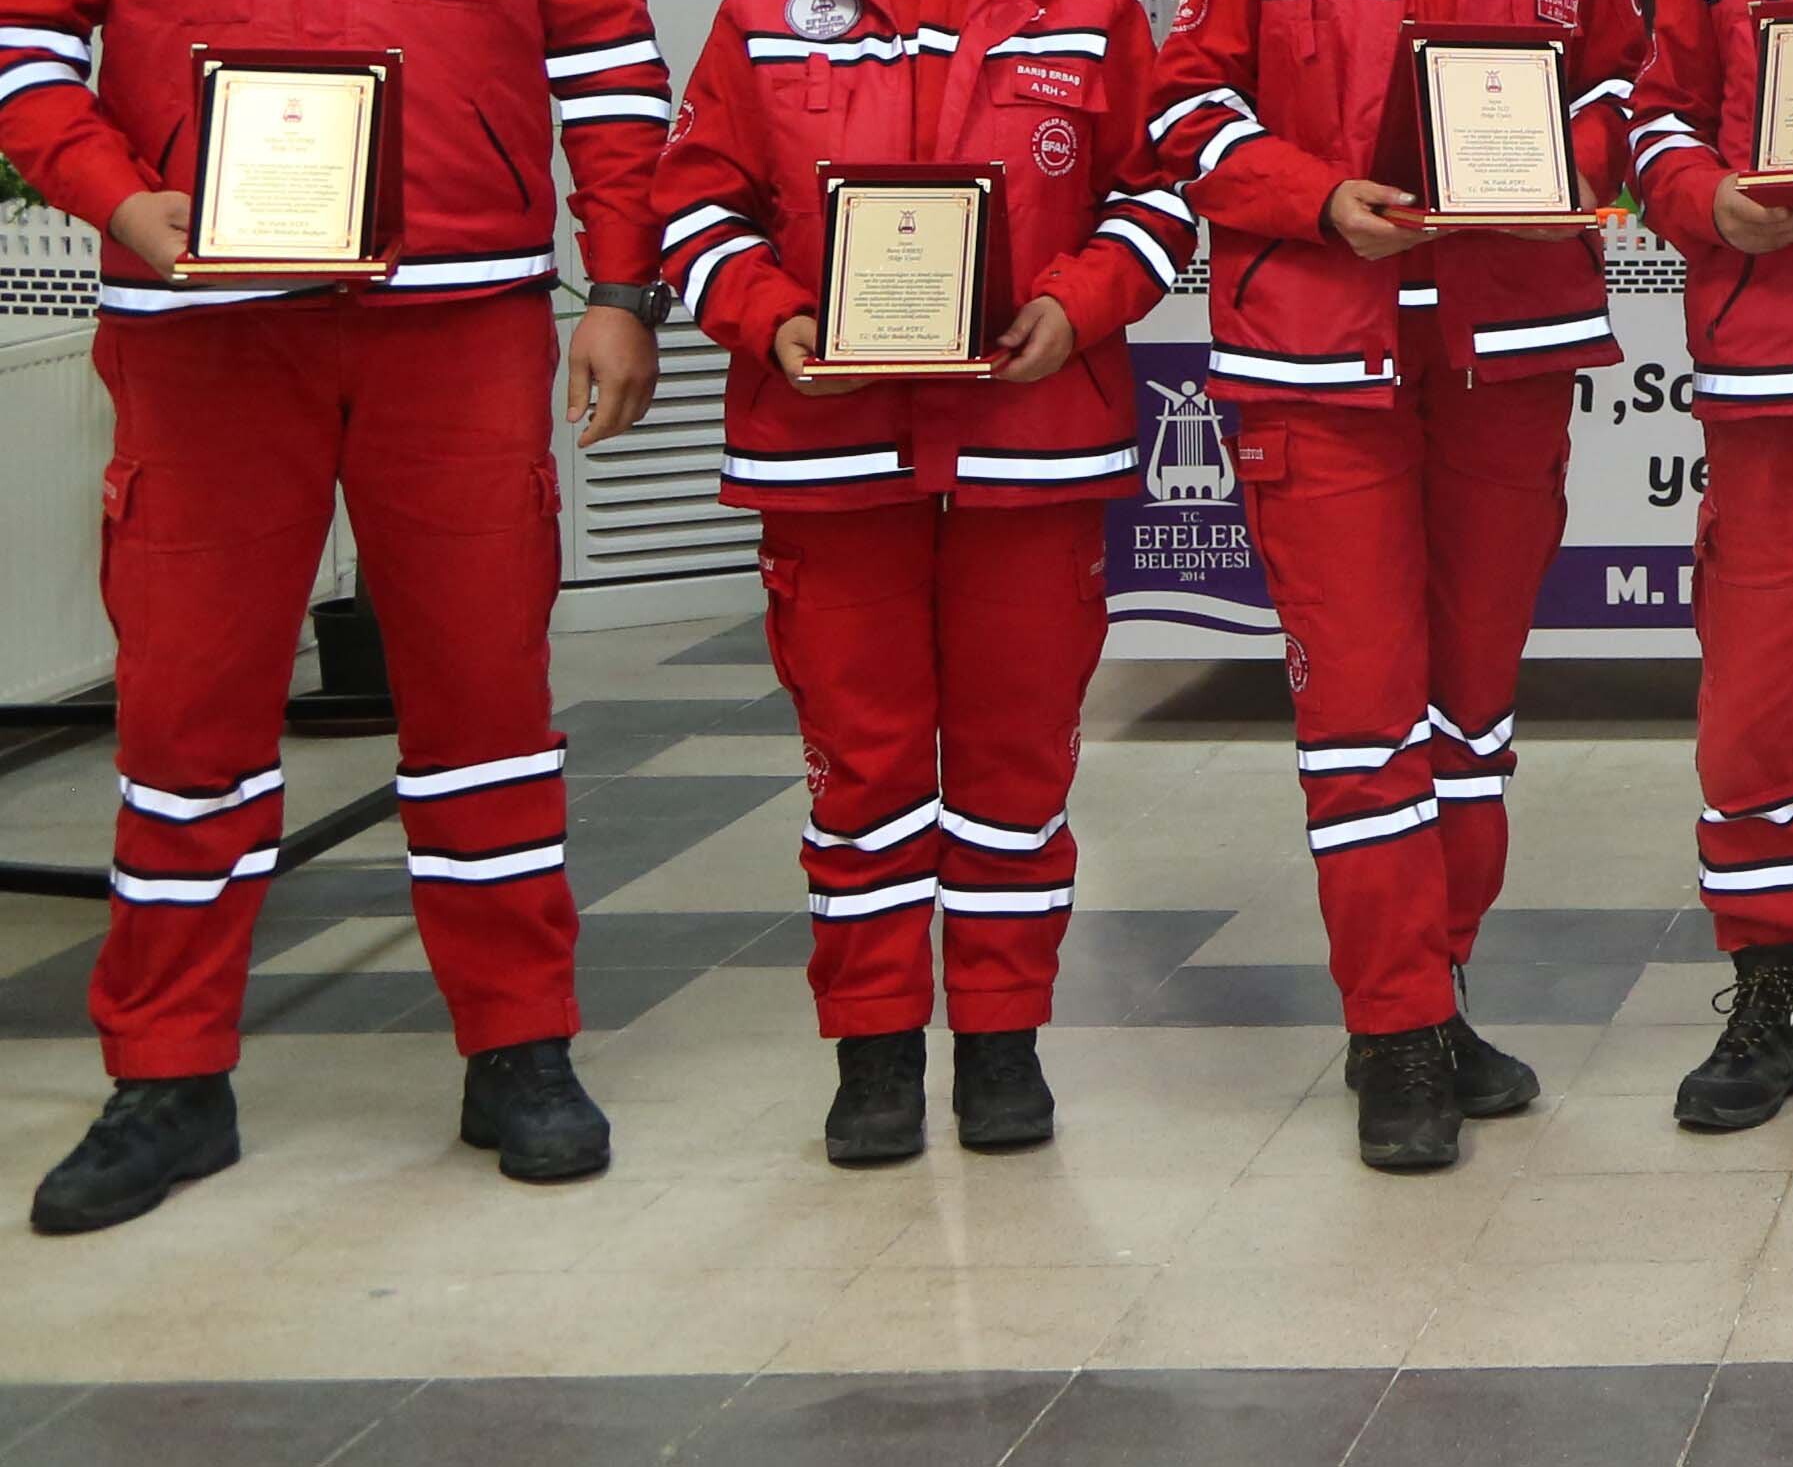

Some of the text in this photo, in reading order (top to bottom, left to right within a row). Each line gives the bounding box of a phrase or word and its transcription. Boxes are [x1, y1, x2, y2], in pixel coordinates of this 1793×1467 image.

[1017, 64, 1081, 87] BARIŞ ERBAŞ
[1031, 82, 1040, 92] A
[1041, 140, 1070, 156] EFAK
[1612, 362, 1694, 425] ,So
[1648, 456, 1710, 507] ye
[1179, 511, 1204, 523] T.C.
[1134, 524, 1251, 549] EFELER
[1134, 549, 1251, 570] BELEDİYESİ
[1179, 570, 1206, 582] 2014
[1605, 566, 1665, 606] M.
